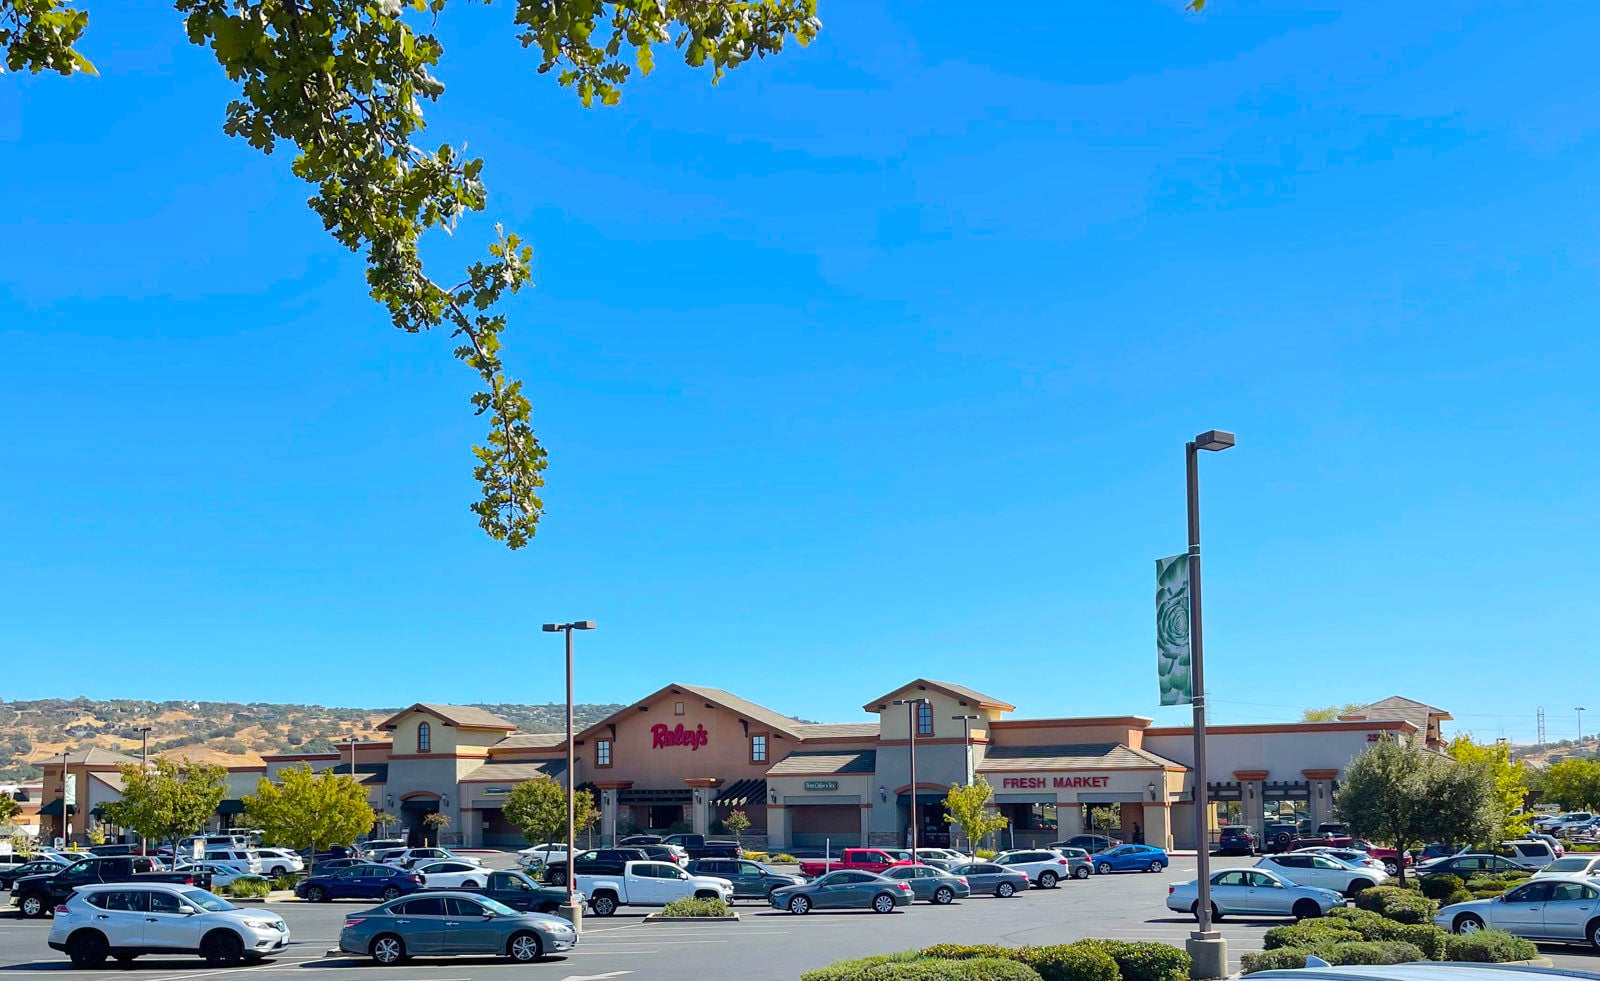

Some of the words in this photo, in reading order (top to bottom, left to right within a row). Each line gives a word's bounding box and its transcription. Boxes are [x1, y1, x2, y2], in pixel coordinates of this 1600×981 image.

[650, 723, 708, 751] Raley's
[1003, 777, 1046, 788] FRESH
[1053, 776, 1109, 787] MARKET
